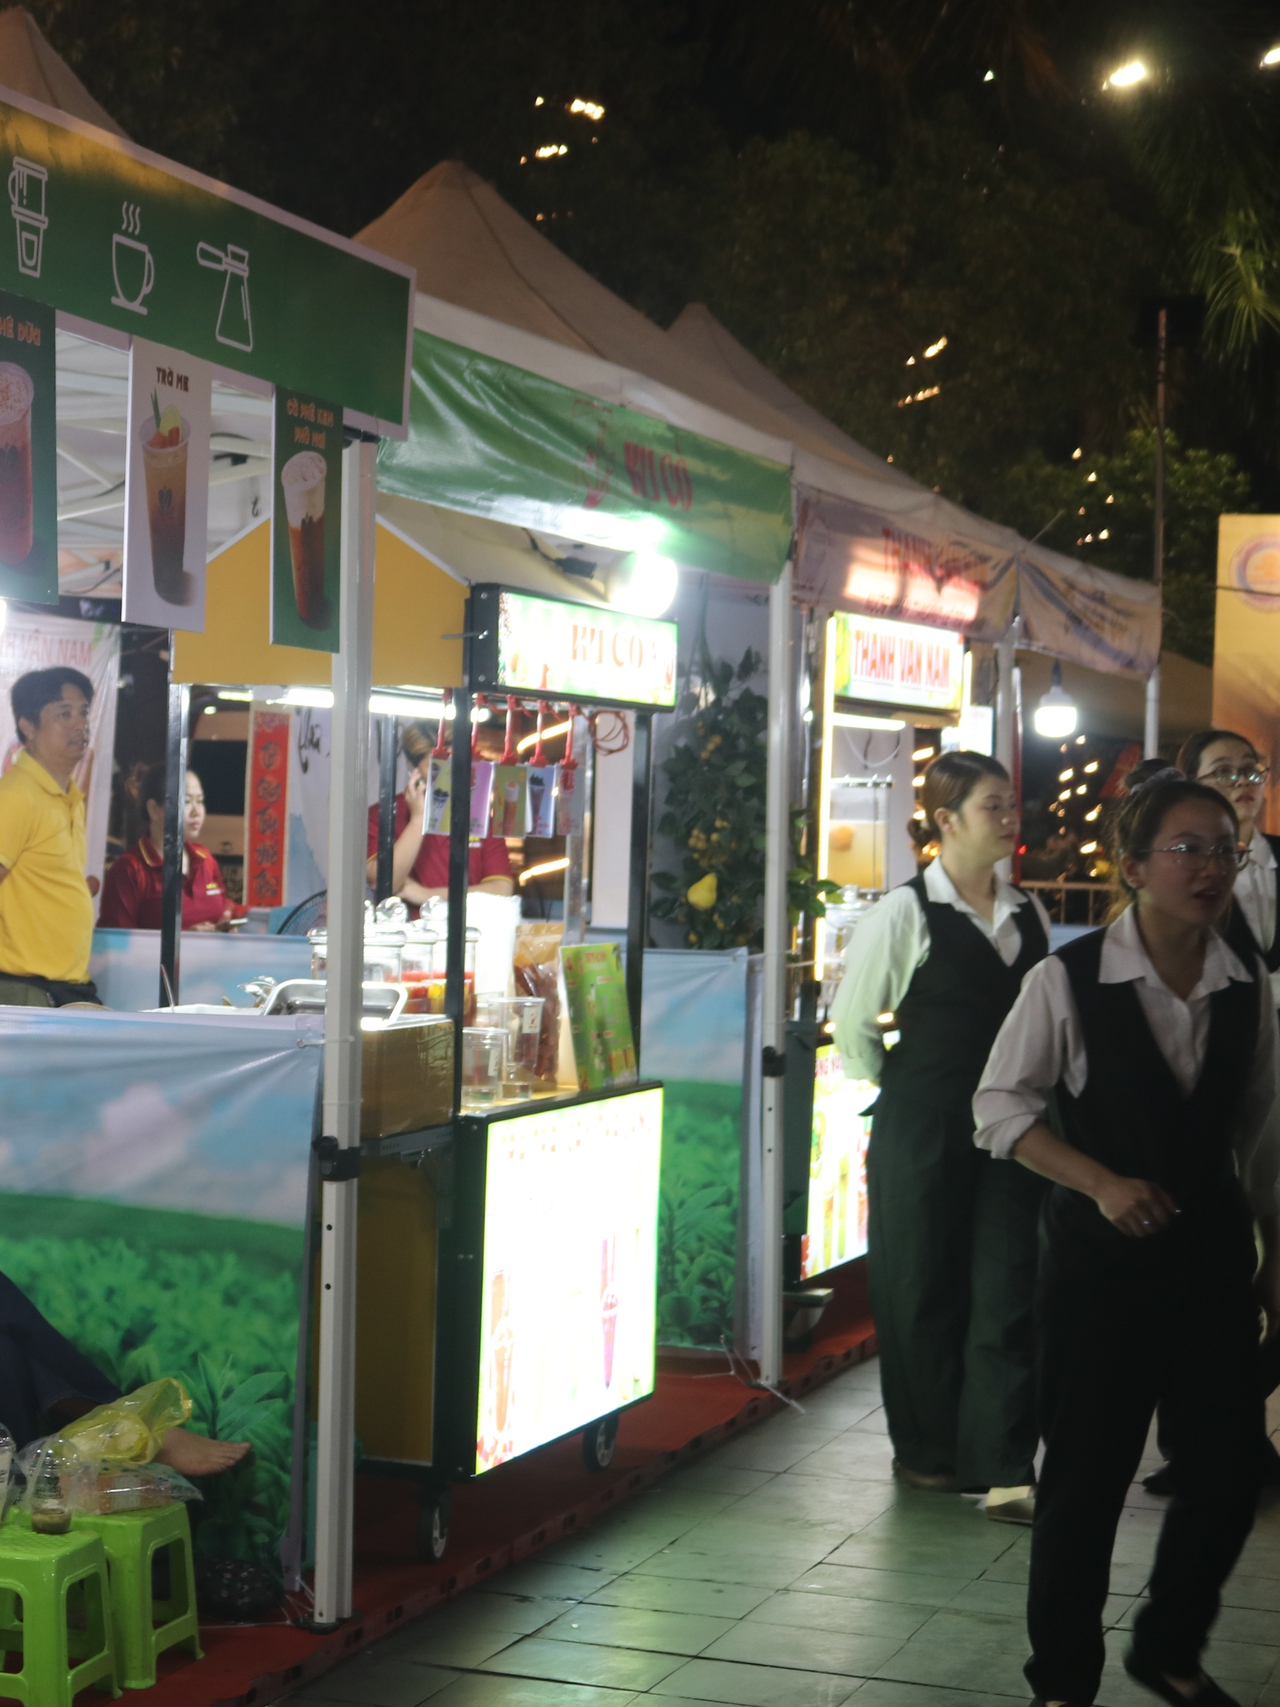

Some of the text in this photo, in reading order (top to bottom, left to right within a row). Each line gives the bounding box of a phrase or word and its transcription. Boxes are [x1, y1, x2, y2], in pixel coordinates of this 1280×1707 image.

[156, 366, 189, 392] TRÀ ME
[57, 637, 92, 667] NAM
[854, 629, 896, 682] THANH
[926, 642, 950, 689] NAM
